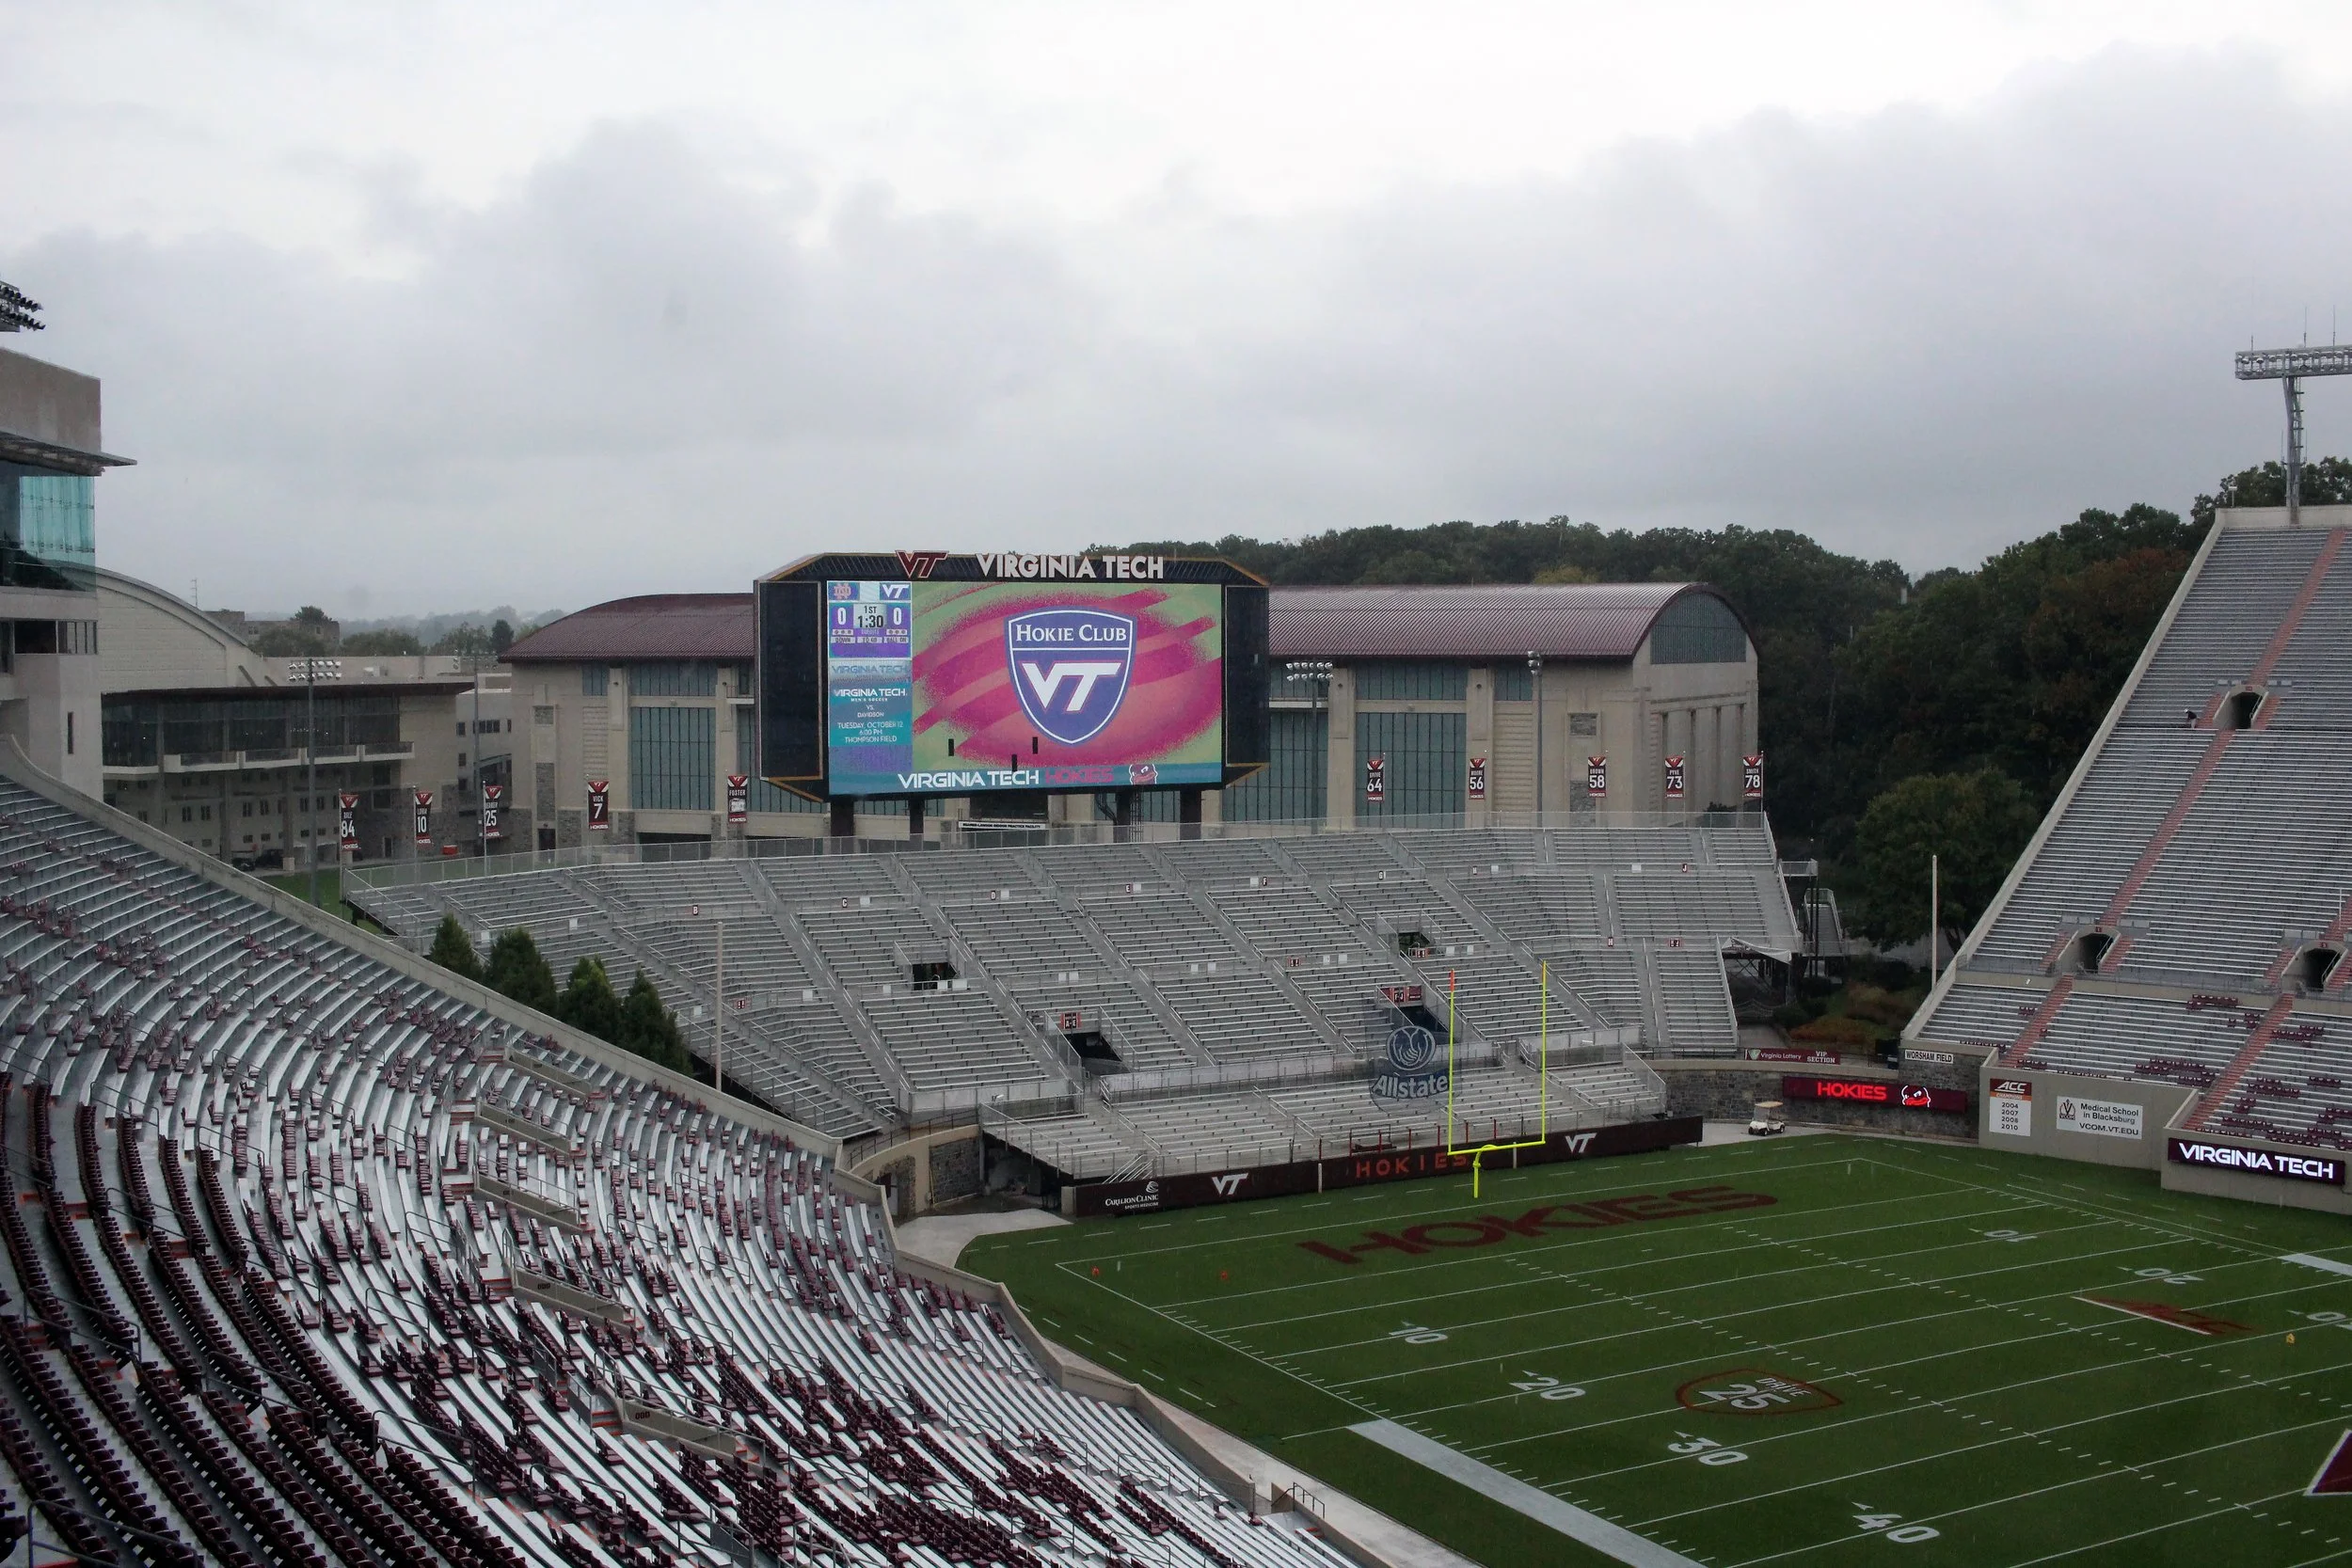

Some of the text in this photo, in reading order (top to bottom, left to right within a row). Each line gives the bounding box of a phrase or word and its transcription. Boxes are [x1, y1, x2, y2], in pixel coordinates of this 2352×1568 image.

[896, 550, 949, 578] VT
[975, 553, 1164, 579] VIRGINIA TECH
[882, 585, 910, 599] VT
[838, 607, 846, 625] 0
[858, 615, 884, 628] 1:30
[893, 607, 902, 625] 0
[1016, 624, 1127, 641] HOKIE CLUB
[832, 665, 877, 673] VIRGINIA
[834, 688, 906, 697] VIRGINIA TECH
[1022, 663, 1121, 712] VT
[898, 768, 1114, 789] VIRGINIA TECH HOKIES
[1367, 779, 1382, 792] 64
[1470, 776, 1483, 789] 56
[1590, 775, 1605, 788] 58
[1667, 776, 1683, 789] 73
[1745, 775, 1760, 788] 78
[486, 810, 497, 827] 25
[594, 803, 603, 819] 7
[341, 820, 355, 837] 84
[417, 816, 427, 833] 10
[693, 906, 698, 914] B
[842, 899, 847, 907] C
[1906, 1050, 1952, 1063] WORSHAM FIELD
[1372, 1074, 1448, 1098] Allstate
[1817, 1082, 1887, 1100] HOKIES
[1995, 1081, 2026, 1092] ACC
[2081, 1103, 2139, 1116] Medical School
[2092, 1112, 2135, 1125] Blacksburg
[2079, 1123, 2138, 1135] VCOM.VT.EDU
[1565, 1132, 1597, 1153] VT
[1356, 1153, 1468, 1176] HOKIES
[2179, 1142, 2333, 1179] VIRGINIA TECH
[1211, 1173, 1249, 1195] VT
[1296, 1185, 1779, 1264] HOKIES
[1388, 1327, 1448, 1344] 10
[1509, 1377, 1586, 1400] 20
[1756, 1377, 1811, 1397] DRIVE
[1699, 1384, 1790, 1409] 25
[1668, 1435, 1748, 1466] 30
[1852, 1511, 1940, 1544] 40
